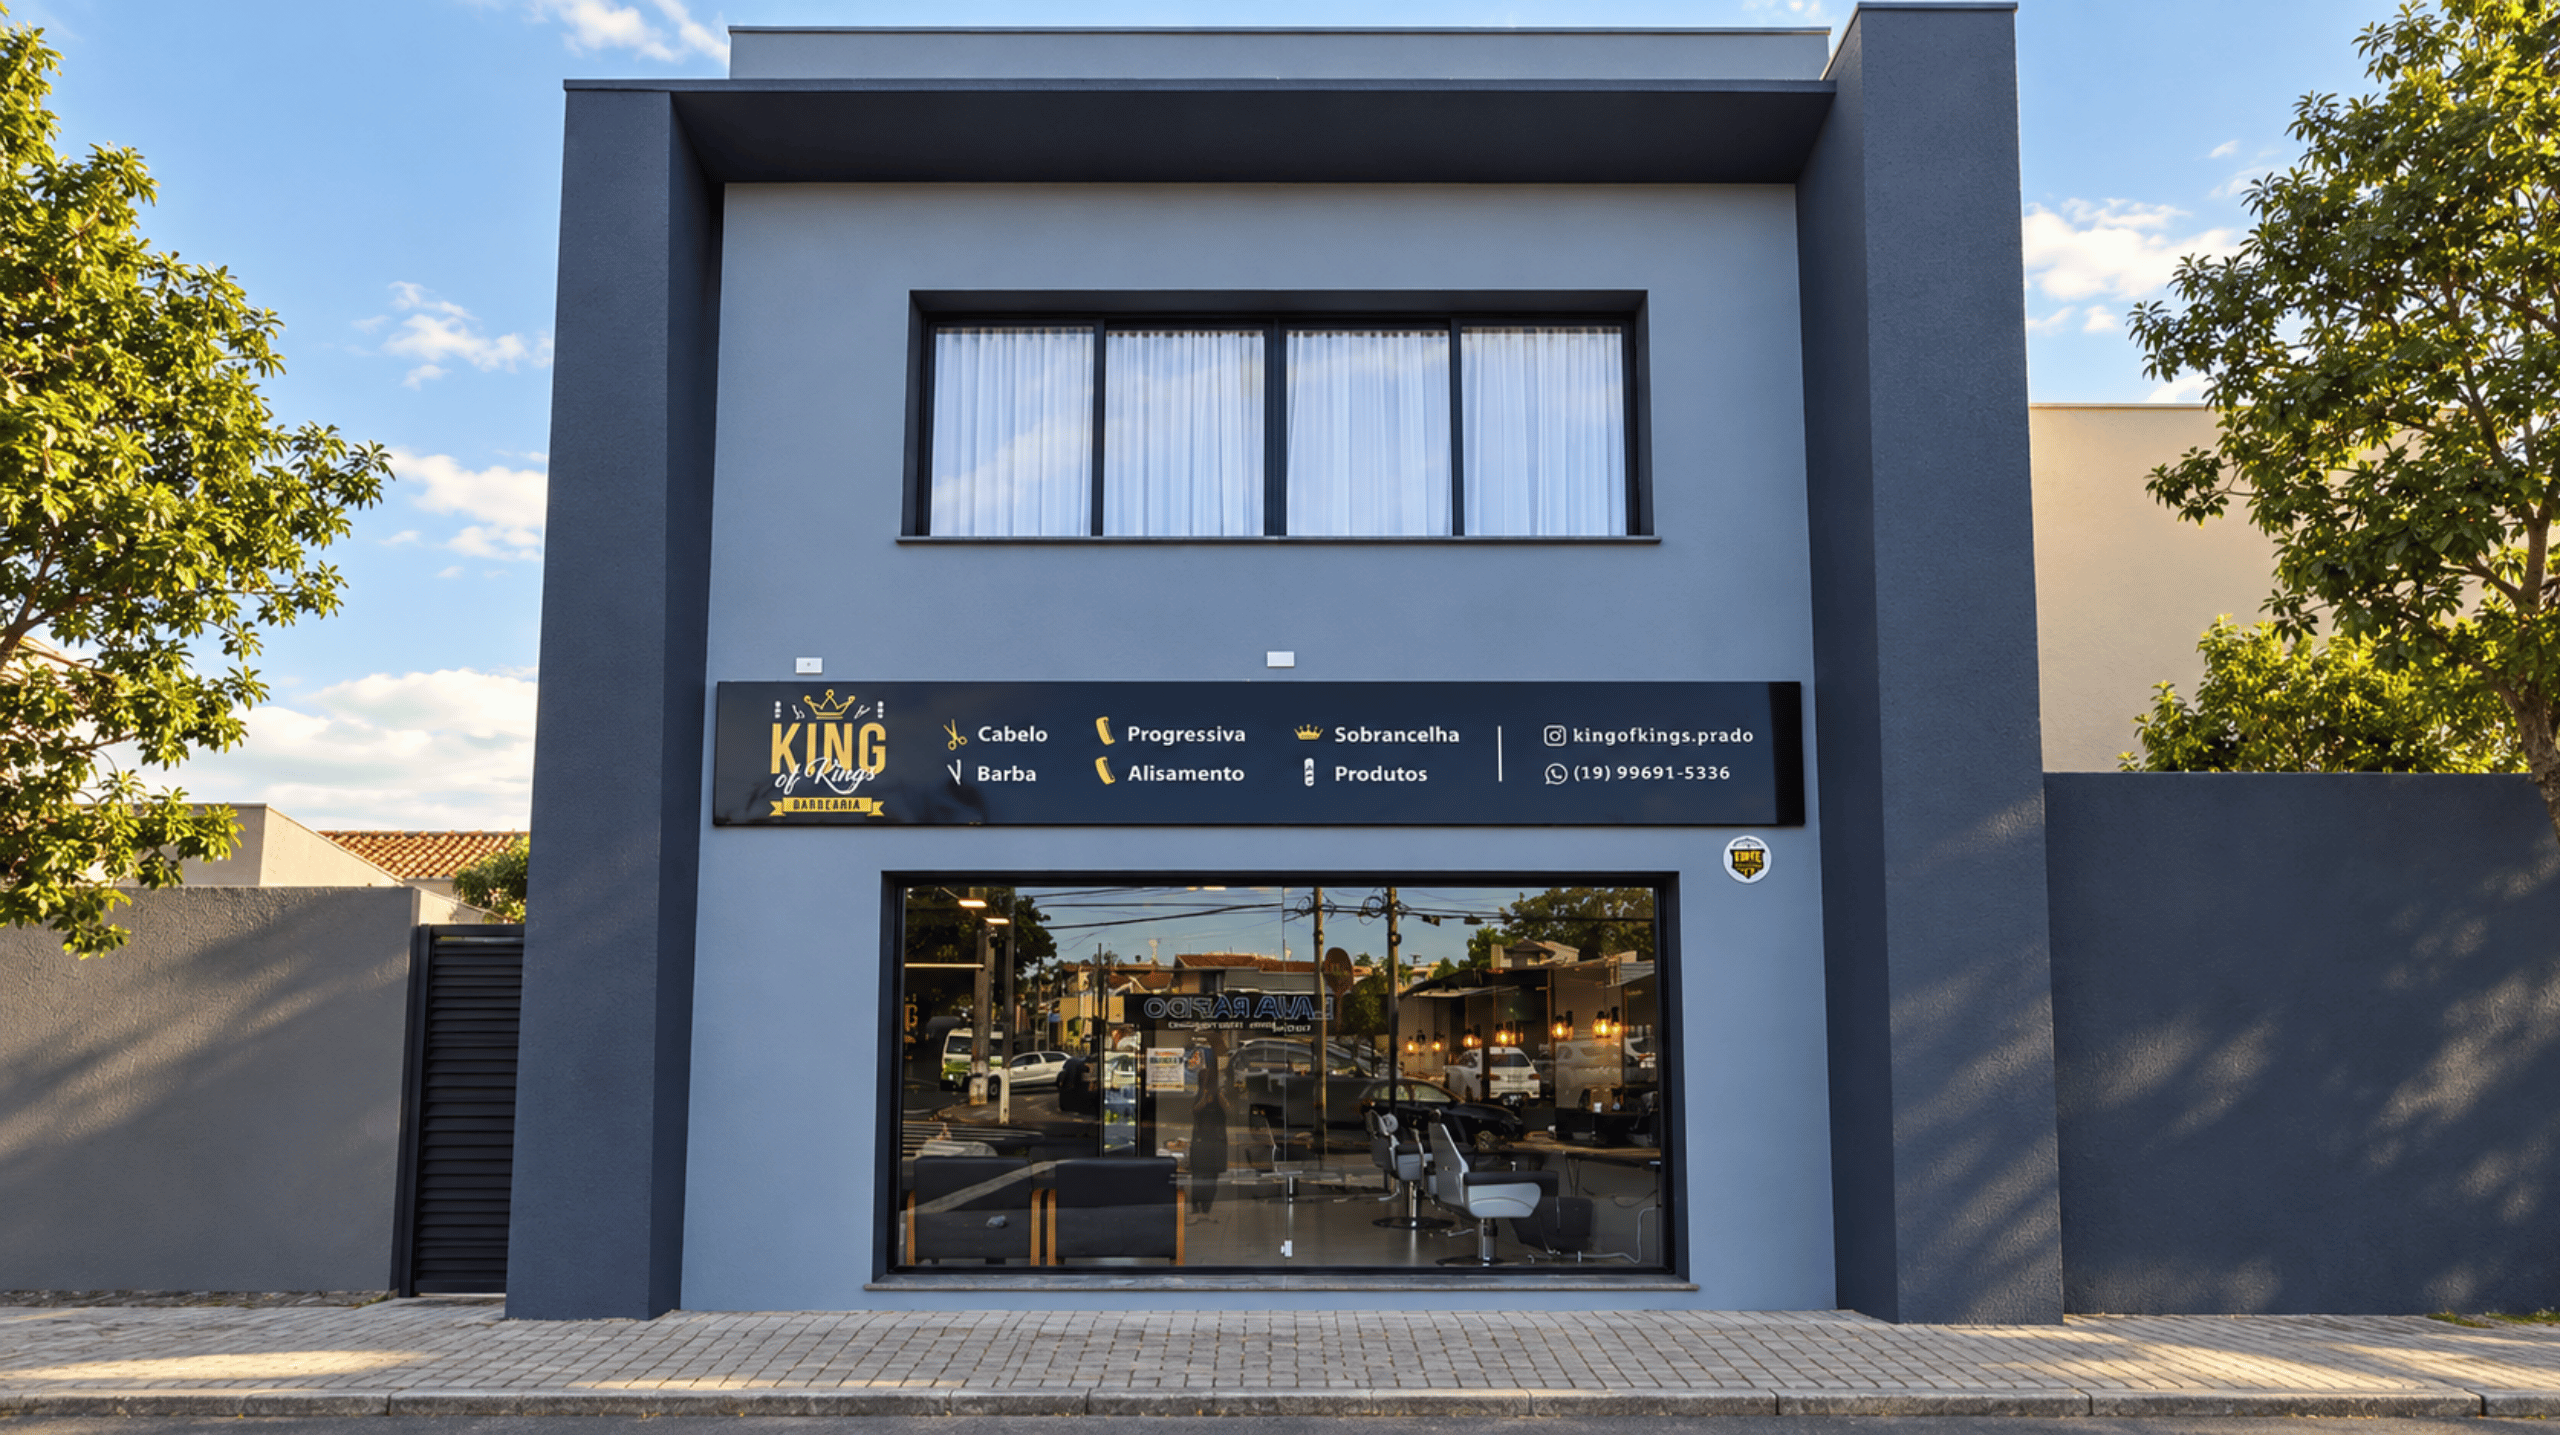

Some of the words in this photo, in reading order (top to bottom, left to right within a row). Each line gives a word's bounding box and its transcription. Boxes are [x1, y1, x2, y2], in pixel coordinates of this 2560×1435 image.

[977, 725, 1048, 743] Cabelo
[1127, 725, 1246, 747] Progressiva
[1334, 725, 1460, 743] Sobrancelha
[1573, 727, 1754, 747] kingofkings.prado
[771, 722, 886, 775] KING
[775, 763, 801, 795] of
[804, 757, 876, 795] Kings
[977, 764, 1037, 782] Barba
[1127, 764, 1245, 782] Alisamento
[1335, 764, 1428, 782] Produtos
[1573, 764, 1611, 783] (19)
[1616, 764, 1731, 780] 99691-5336
